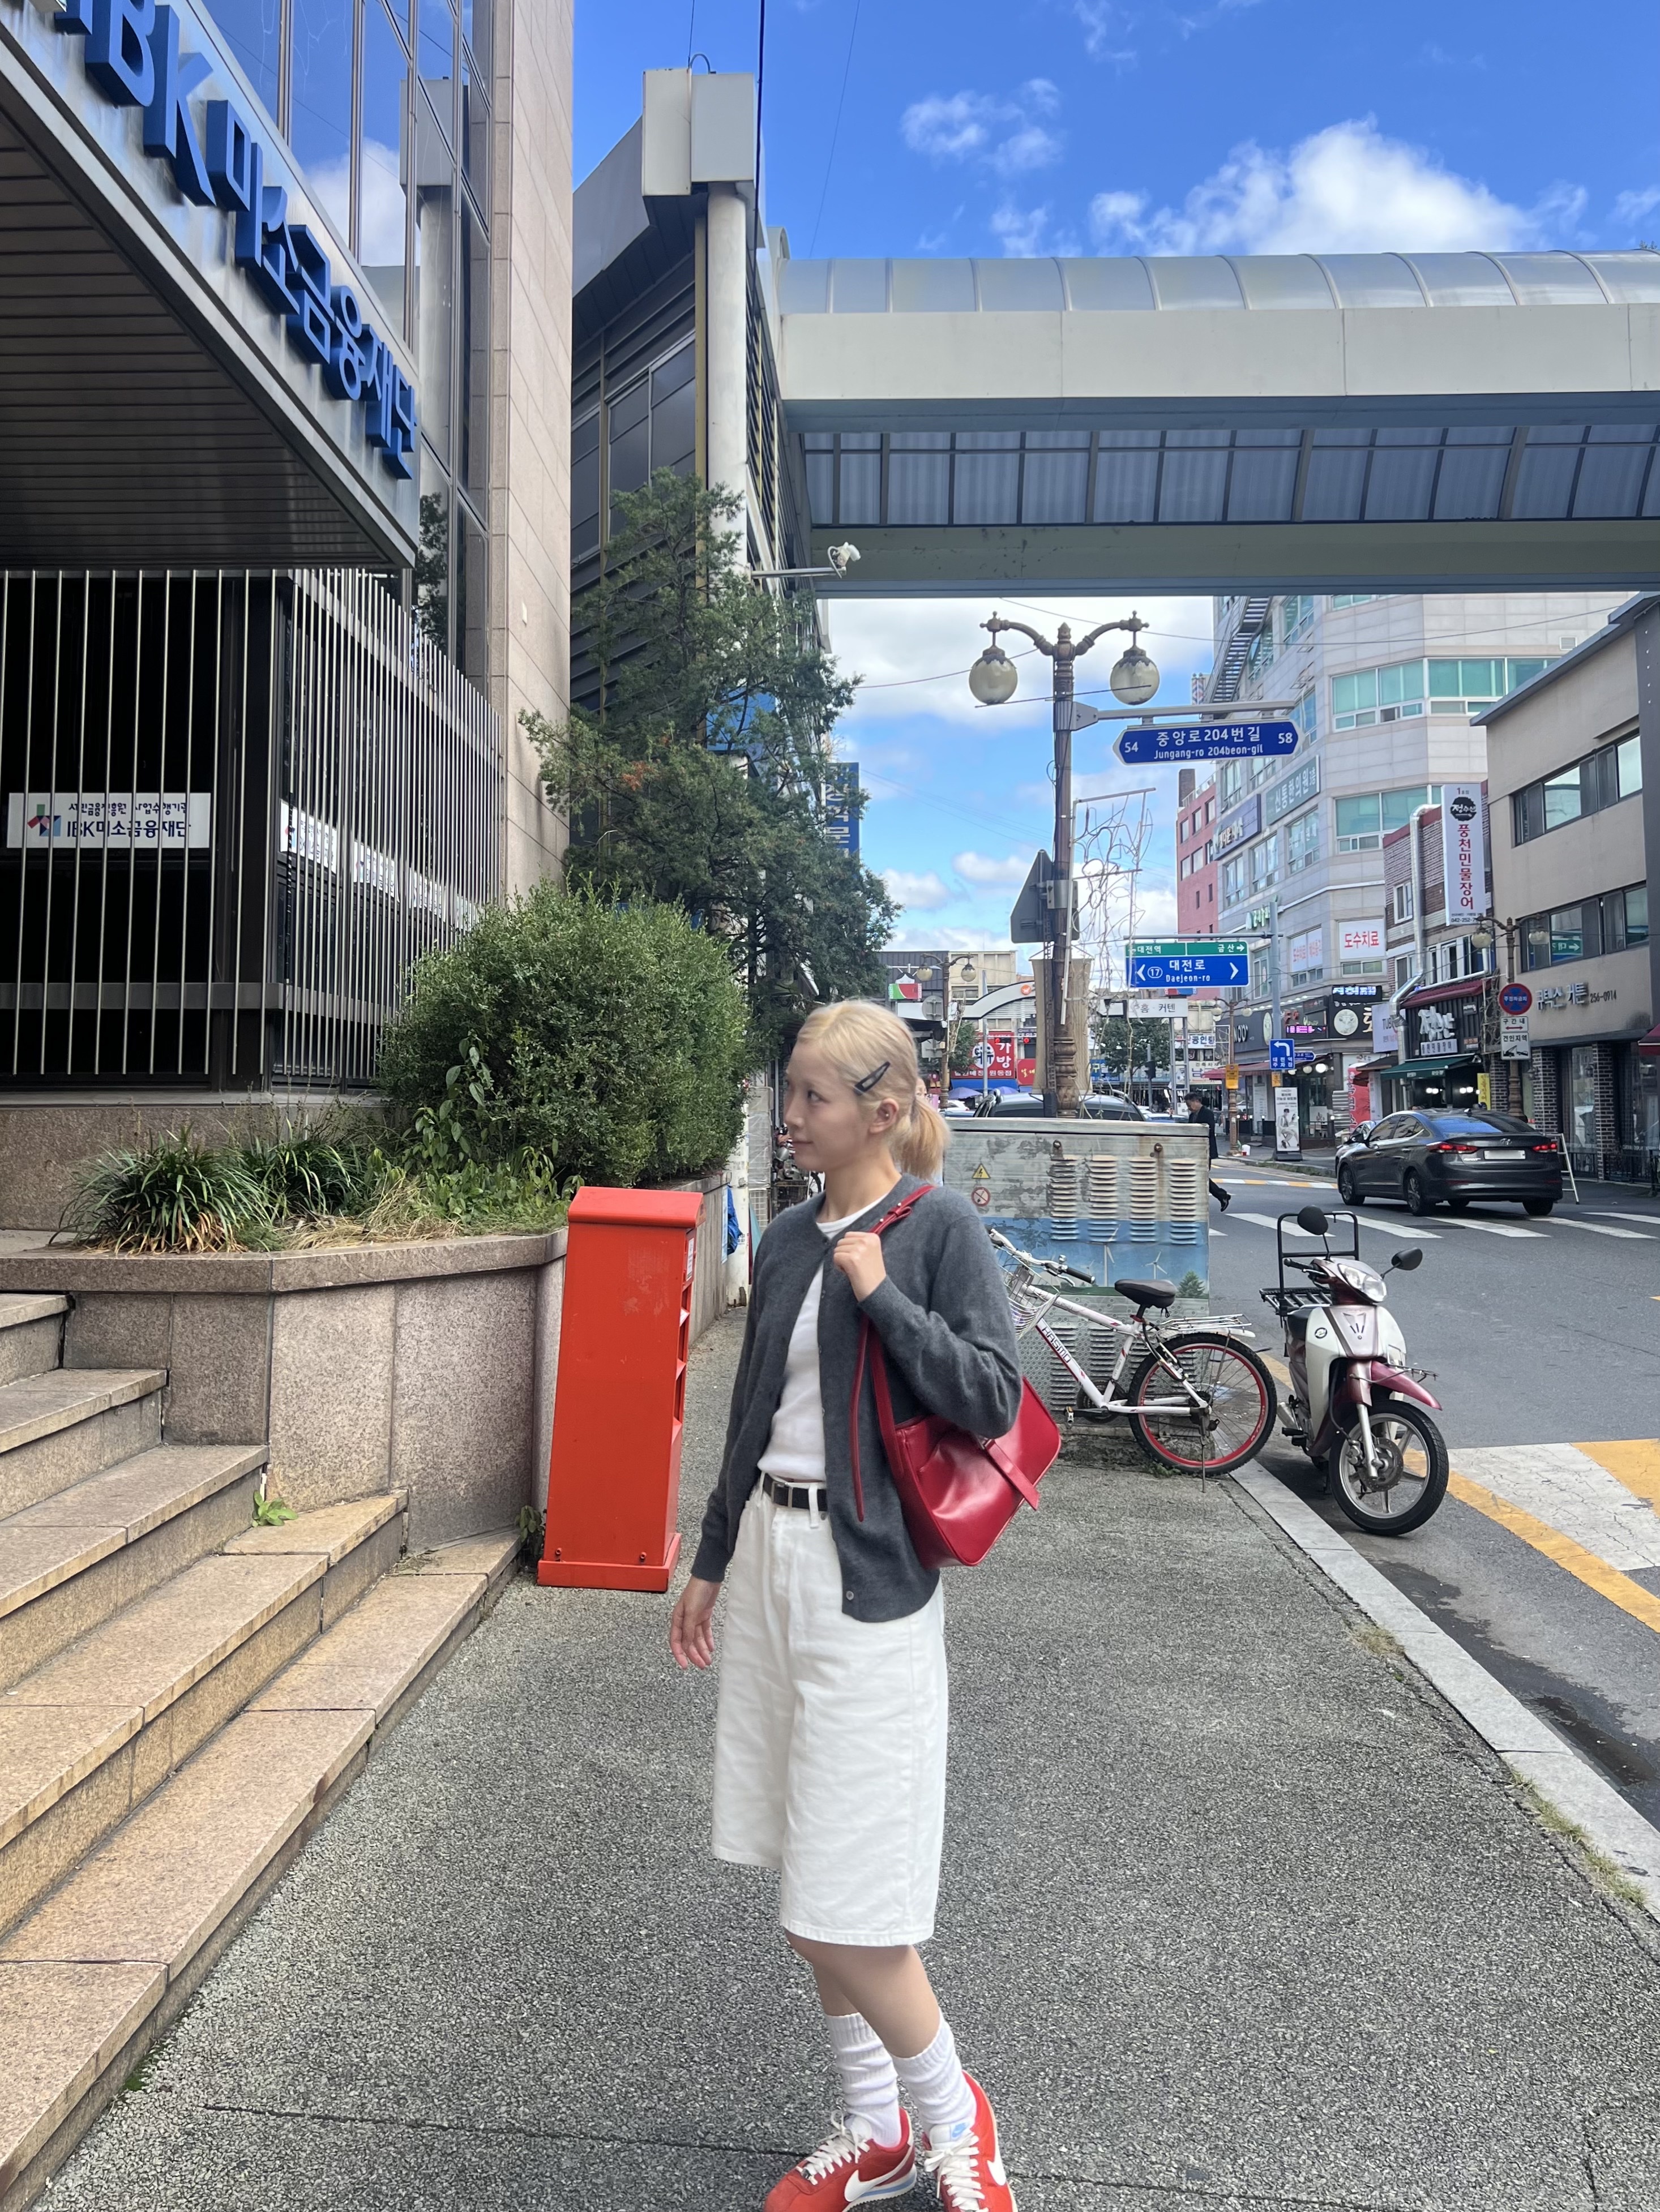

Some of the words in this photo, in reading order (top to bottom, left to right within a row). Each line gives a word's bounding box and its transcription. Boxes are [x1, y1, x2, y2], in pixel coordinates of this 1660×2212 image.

[55, 0, 417, 479] BK미소금융재단
[1278, 733, 1293, 744] 58
[1124, 742, 1139, 753] 54
[1153, 748, 1204, 760] Jungang-ro
[1208, 743, 1264, 756] 204beon-gil
[1274, 767, 1310, 813] 신통한의원
[1457, 824, 1474, 910] 풍천민물장어
[1345, 931, 1379, 949] 도수치료
[1137, 945, 1162, 954] 대전역
[1217, 944, 1235, 953] 금산
[1169, 959, 1206, 972] 대전로
[1150, 968, 1160, 977] 17
[1166, 974, 1210, 983] Daejeon-ro
[1590, 989, 1617, 1003] 256-0914
[1140, 1004, 1149, 1013] 홈
[1158, 1003, 1176, 1013] 커텐
[995, 1042, 1012, 1068] 가방
